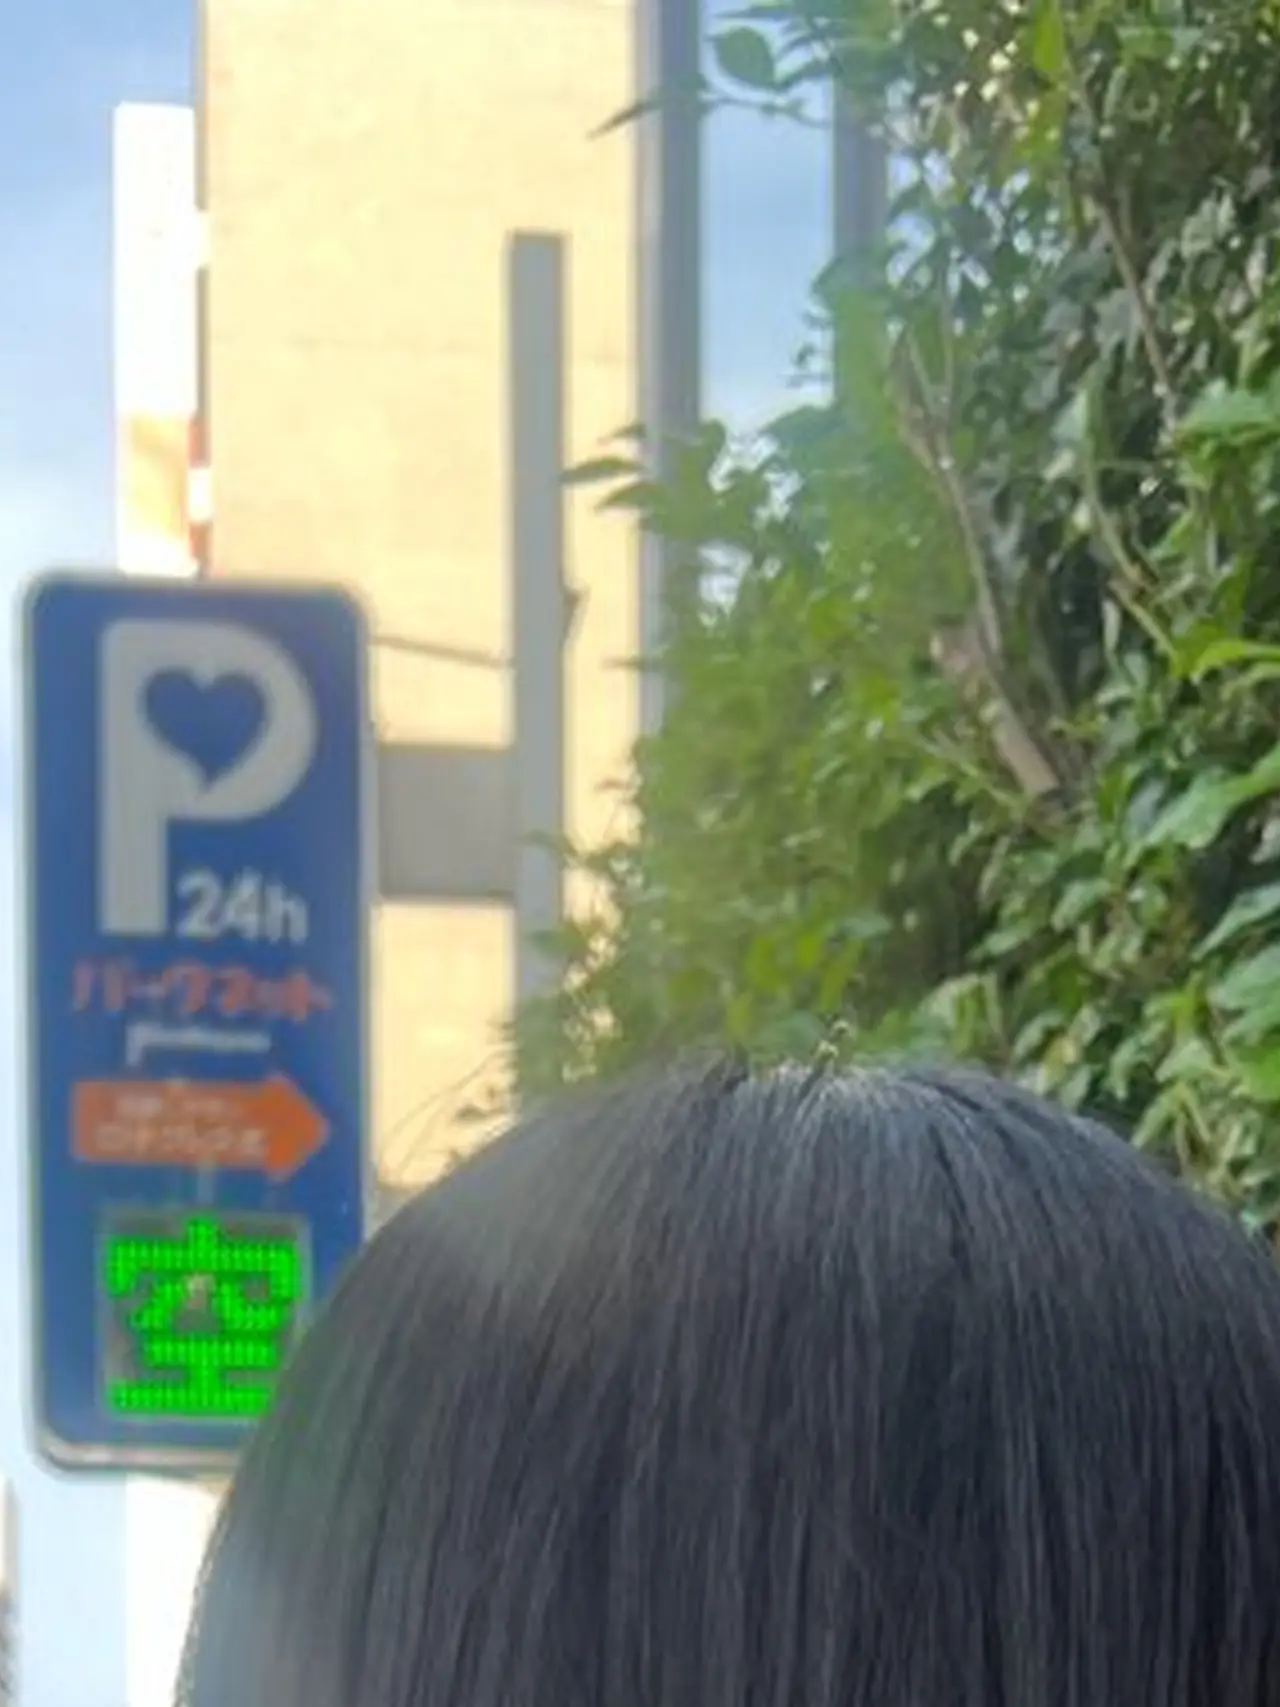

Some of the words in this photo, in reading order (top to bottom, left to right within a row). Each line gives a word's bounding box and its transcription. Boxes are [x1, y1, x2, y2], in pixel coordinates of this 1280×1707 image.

[99, 619, 317, 936] P
[175, 868, 308, 945] 24h
[106, 1213, 302, 1419] 空
